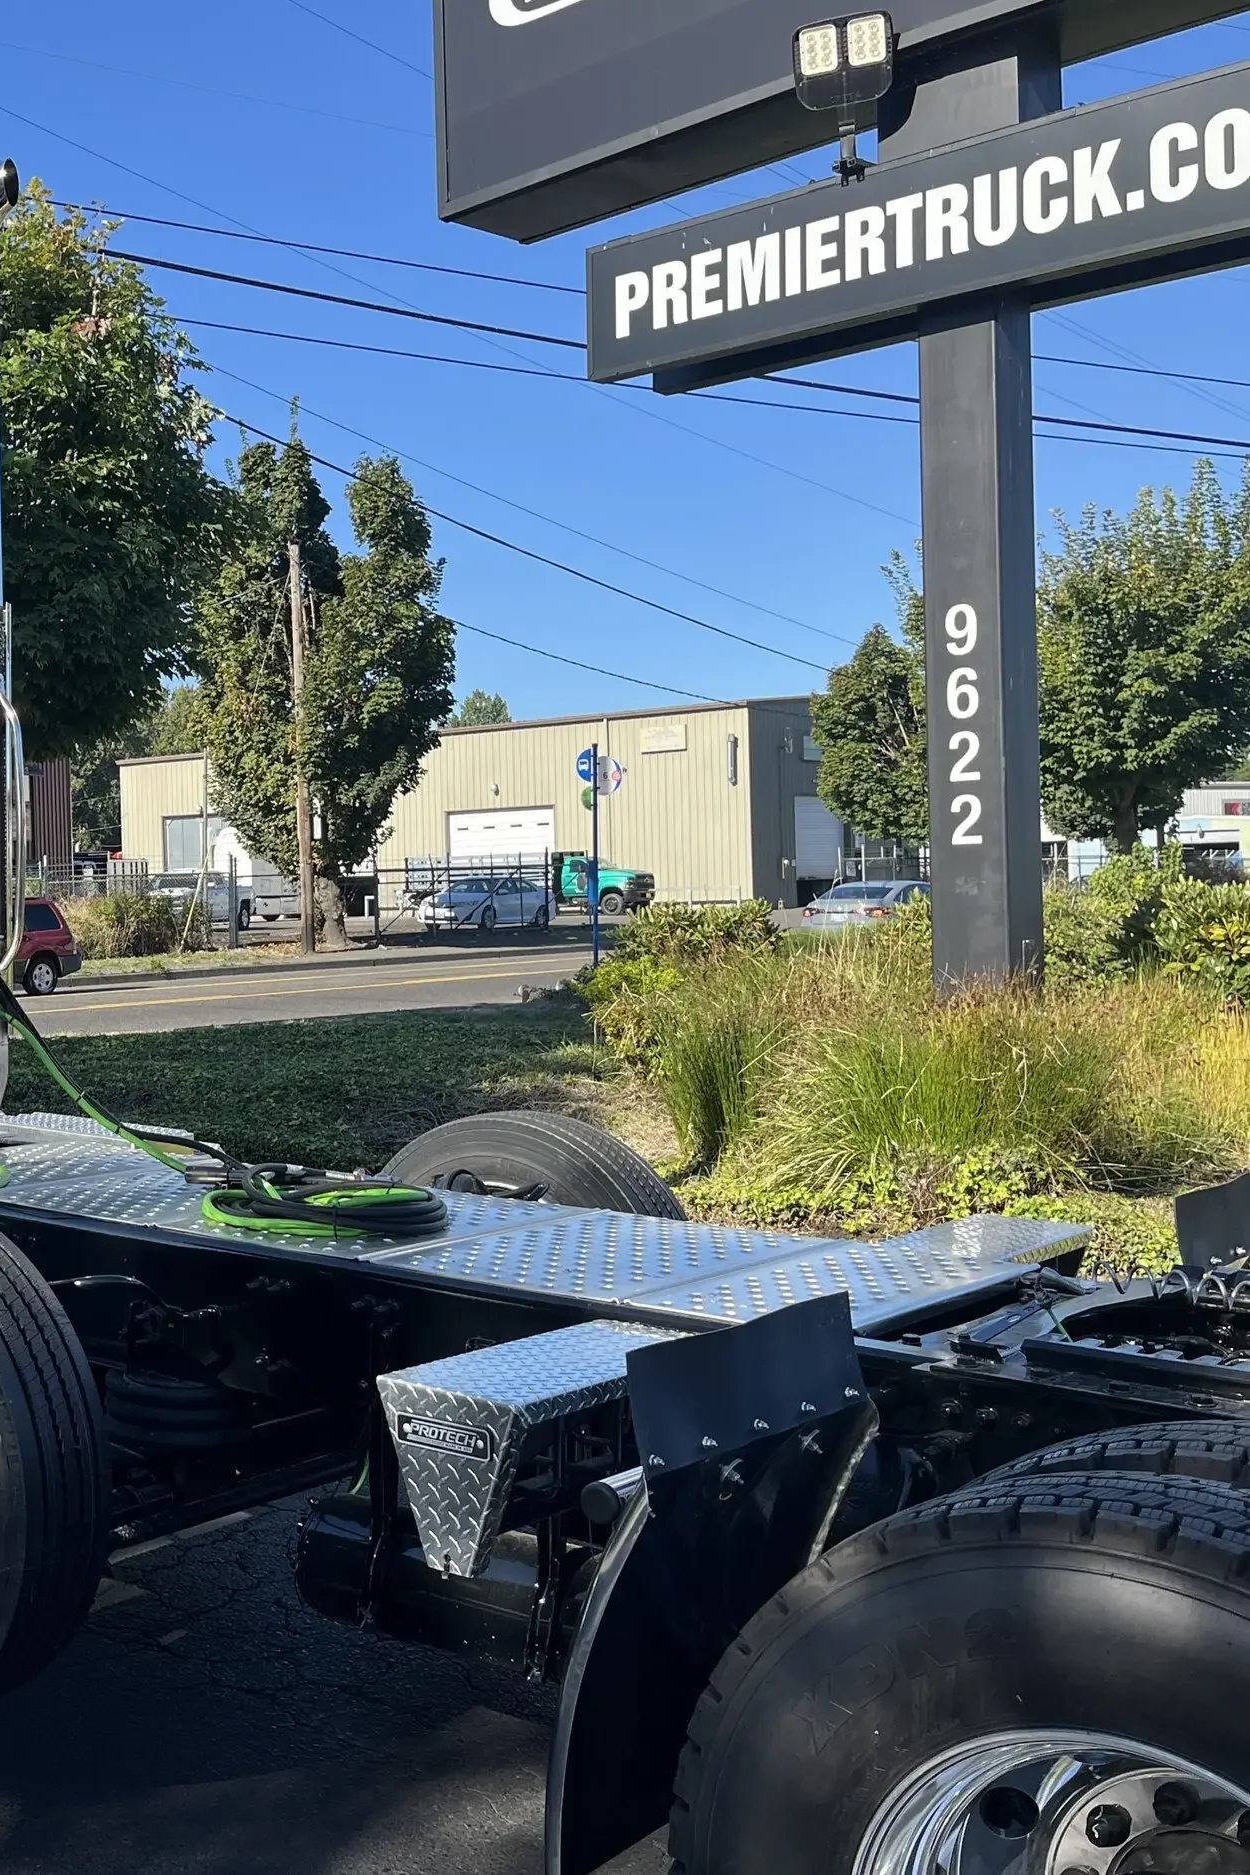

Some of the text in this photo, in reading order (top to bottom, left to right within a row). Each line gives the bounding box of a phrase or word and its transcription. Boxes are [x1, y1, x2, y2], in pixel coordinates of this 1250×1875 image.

[614, 107, 1250, 339] PREMIERTRUCK.CO
[944, 603, 983, 846] 9622
[410, 1422, 477, 1448] PROTECH
